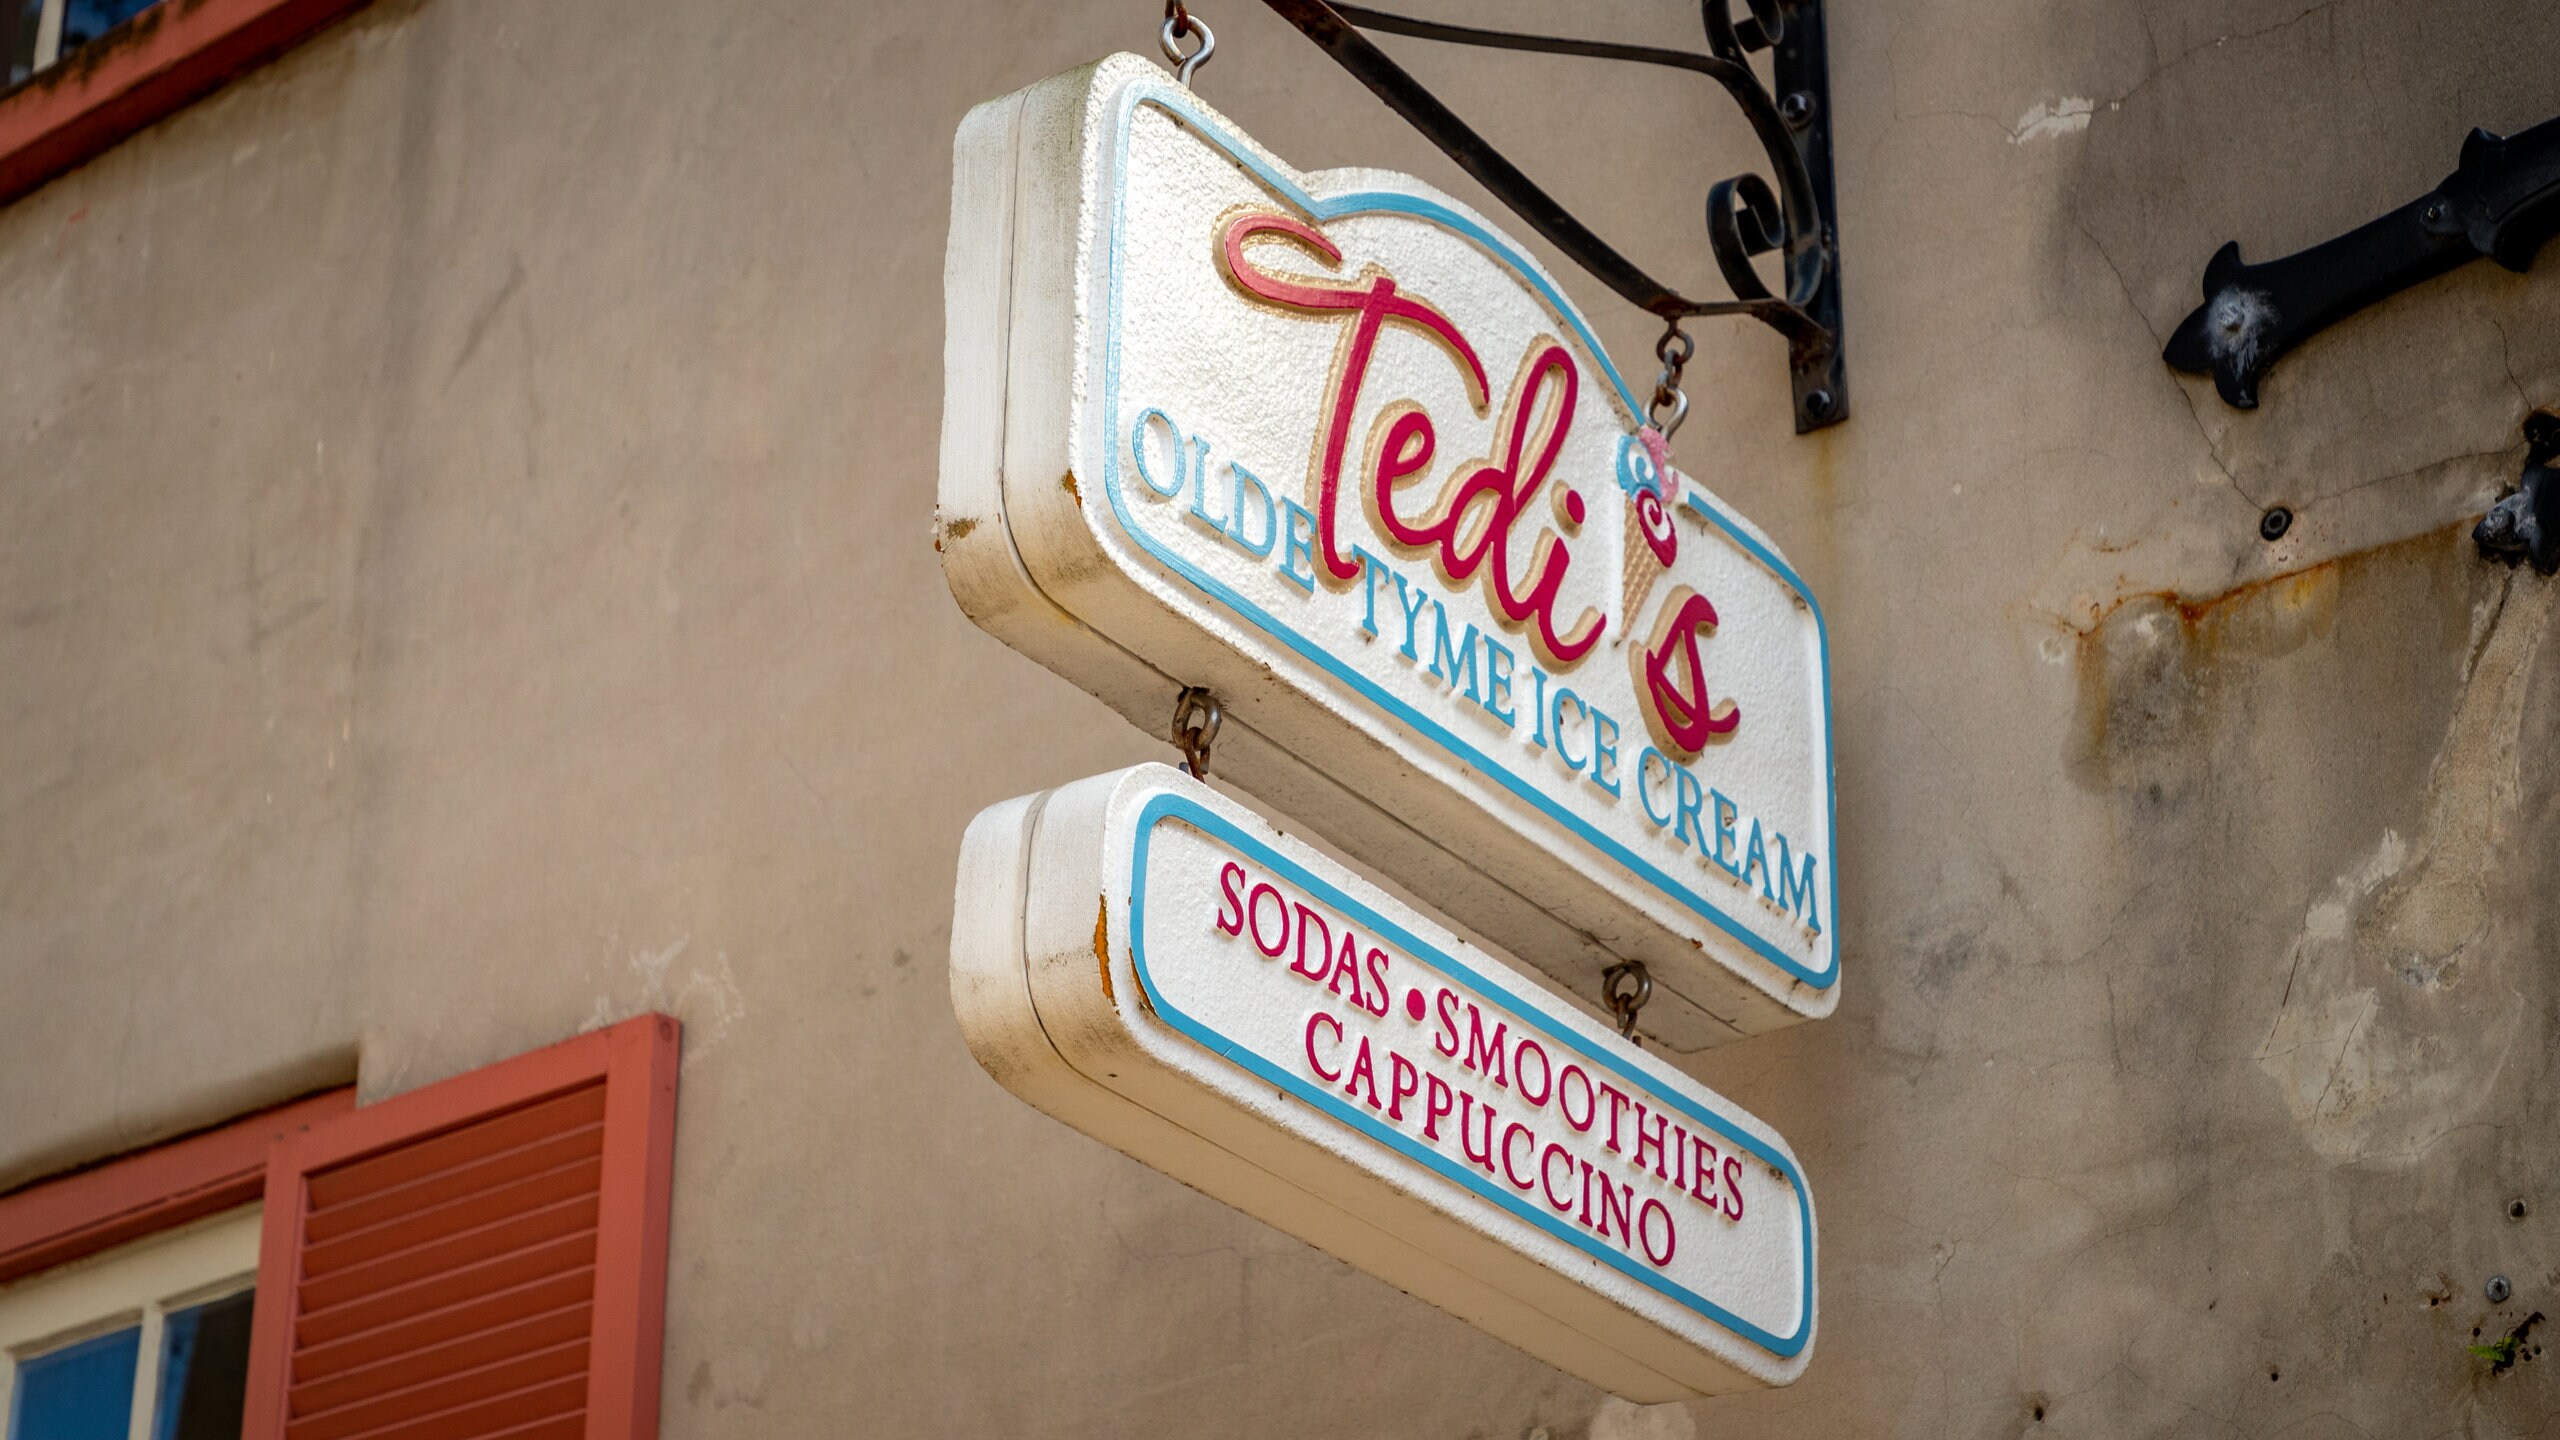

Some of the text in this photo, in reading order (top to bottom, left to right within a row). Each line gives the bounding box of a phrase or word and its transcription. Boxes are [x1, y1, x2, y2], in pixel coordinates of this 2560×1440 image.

[1132, 407, 1822, 935] OLDE TYME ICE CREAM
[1216, 862, 1744, 1222] SODAS SMOOTHIES
[1305, 1012, 1676, 1267] CAPPUCCINO
